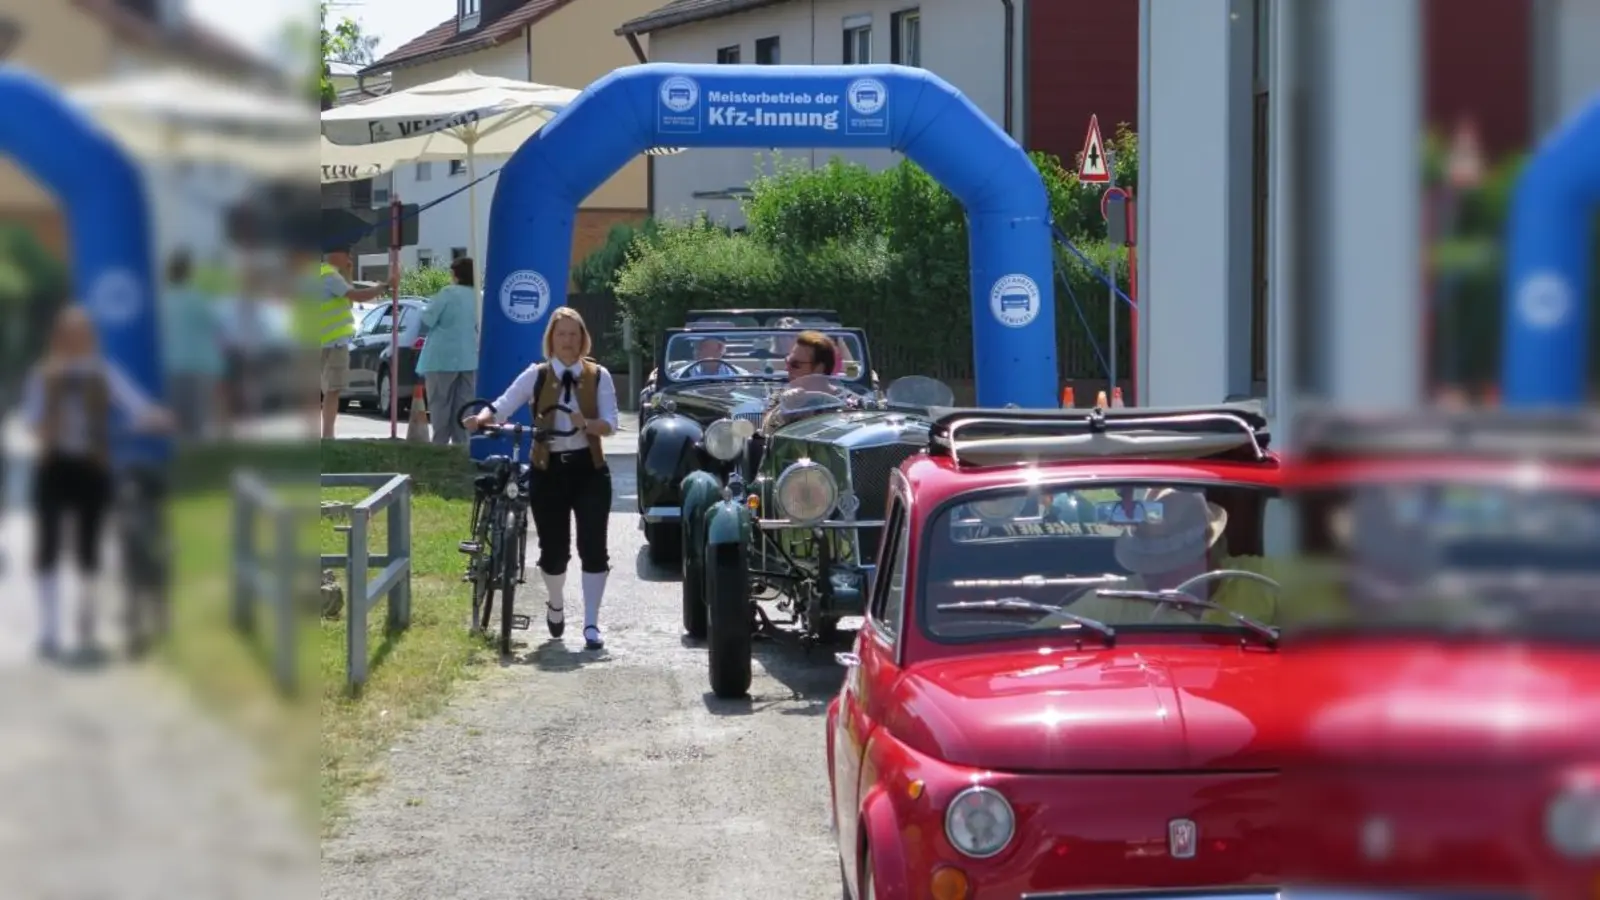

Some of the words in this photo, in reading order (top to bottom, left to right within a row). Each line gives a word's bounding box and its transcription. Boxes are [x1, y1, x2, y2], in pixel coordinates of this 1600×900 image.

[708, 91, 812, 104] Meisterbetrieb
[814, 92, 839, 104] der
[708, 106, 839, 130] Kfz-Innung
